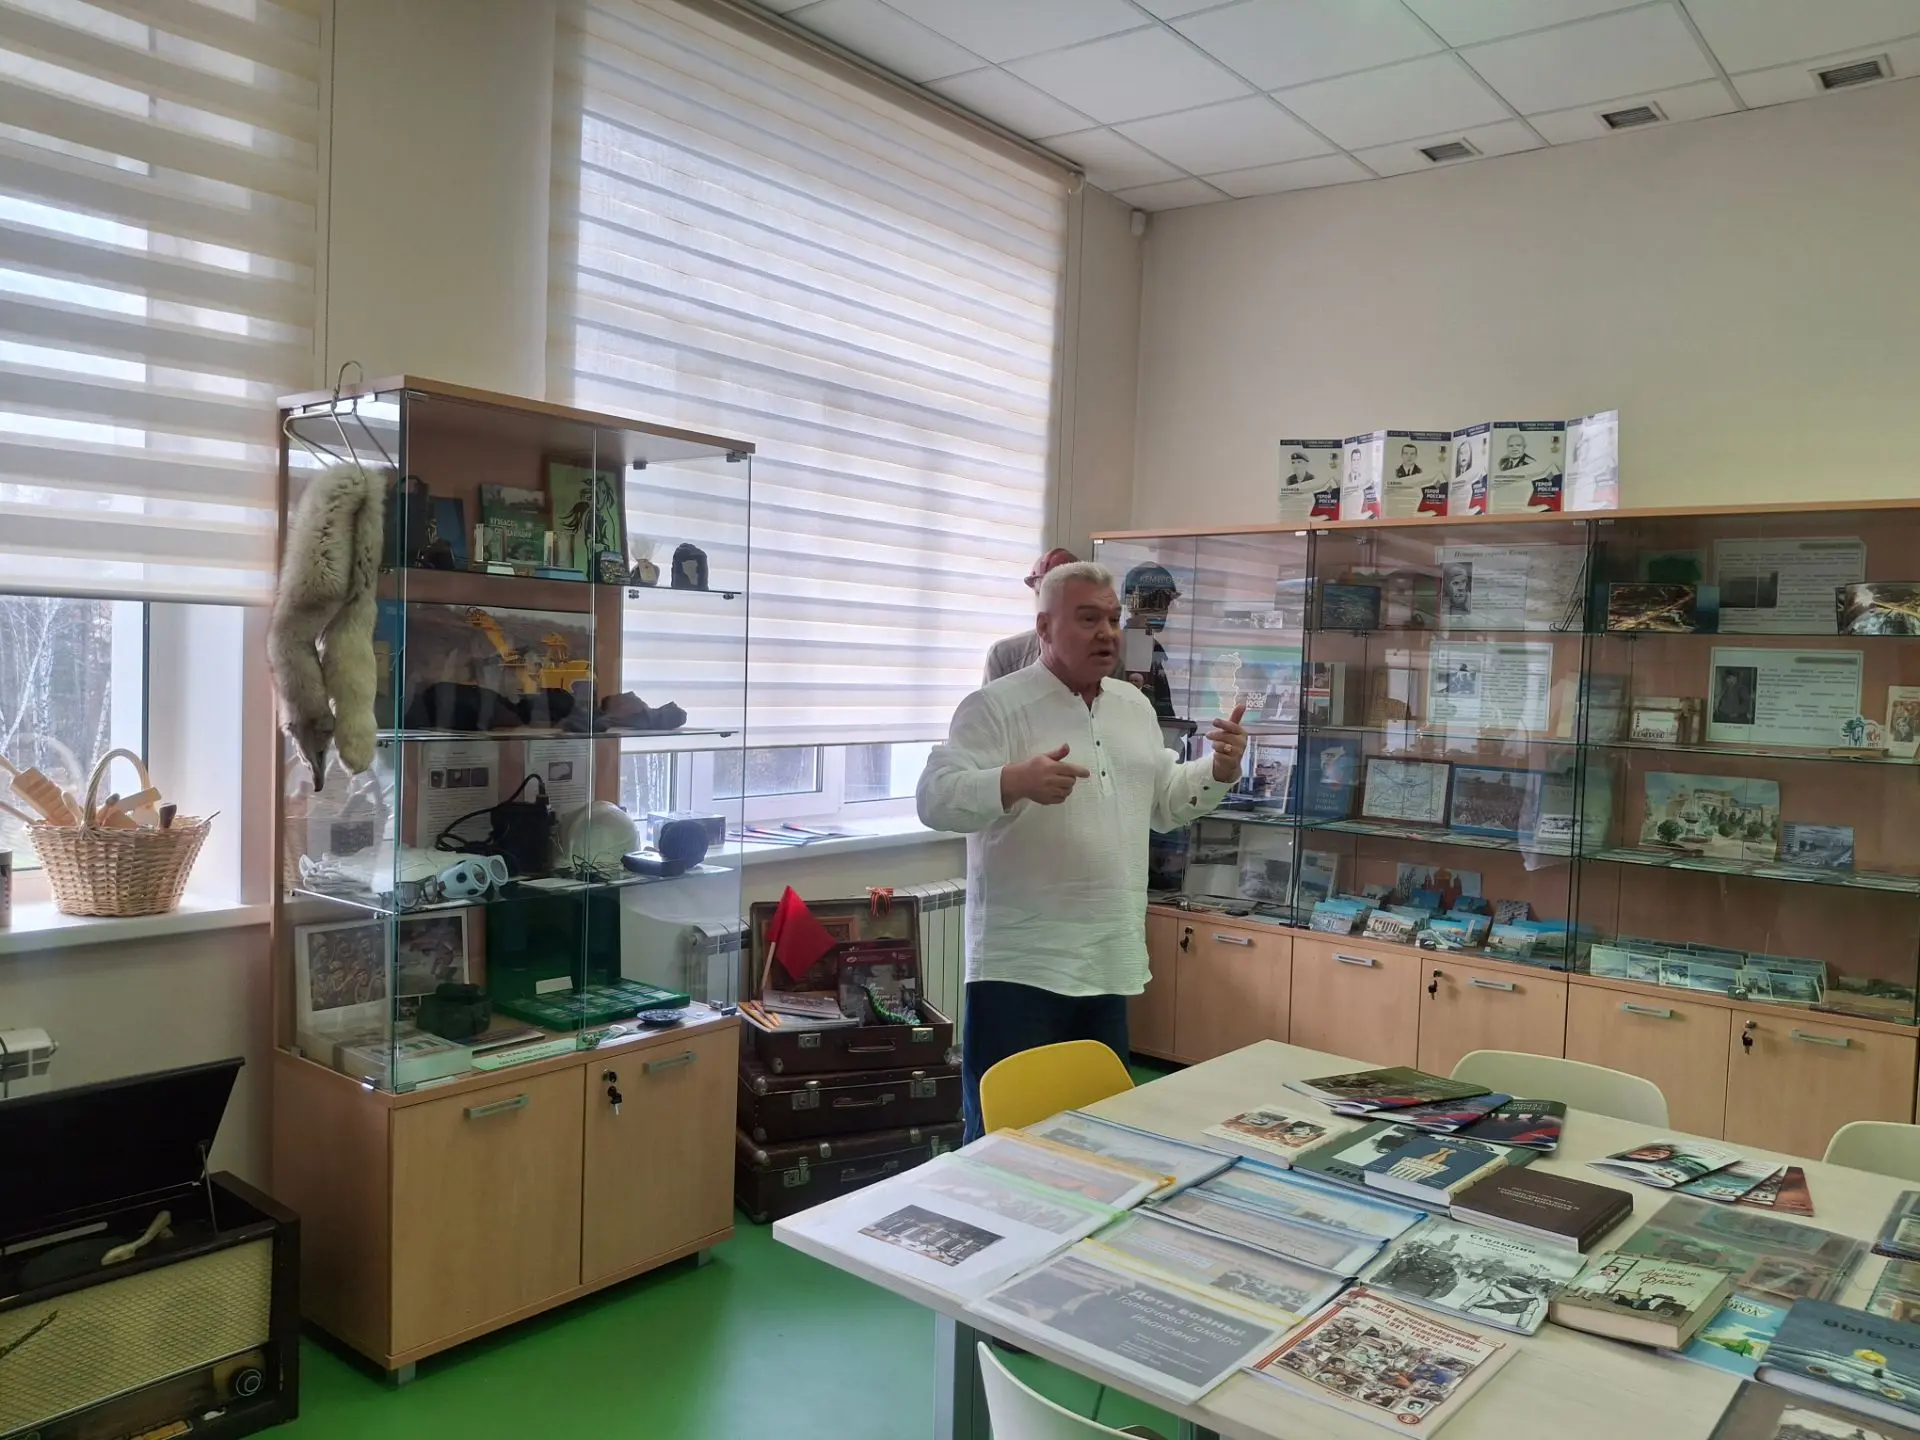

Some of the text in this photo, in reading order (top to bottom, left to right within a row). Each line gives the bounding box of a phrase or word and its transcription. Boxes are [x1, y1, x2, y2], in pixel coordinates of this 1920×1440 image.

[1128, 1289, 1175, 1310] Дети
[1116, 1295, 1242, 1347] Толкачева Тамара
[1130, 1313, 1201, 1344] Ивановна
